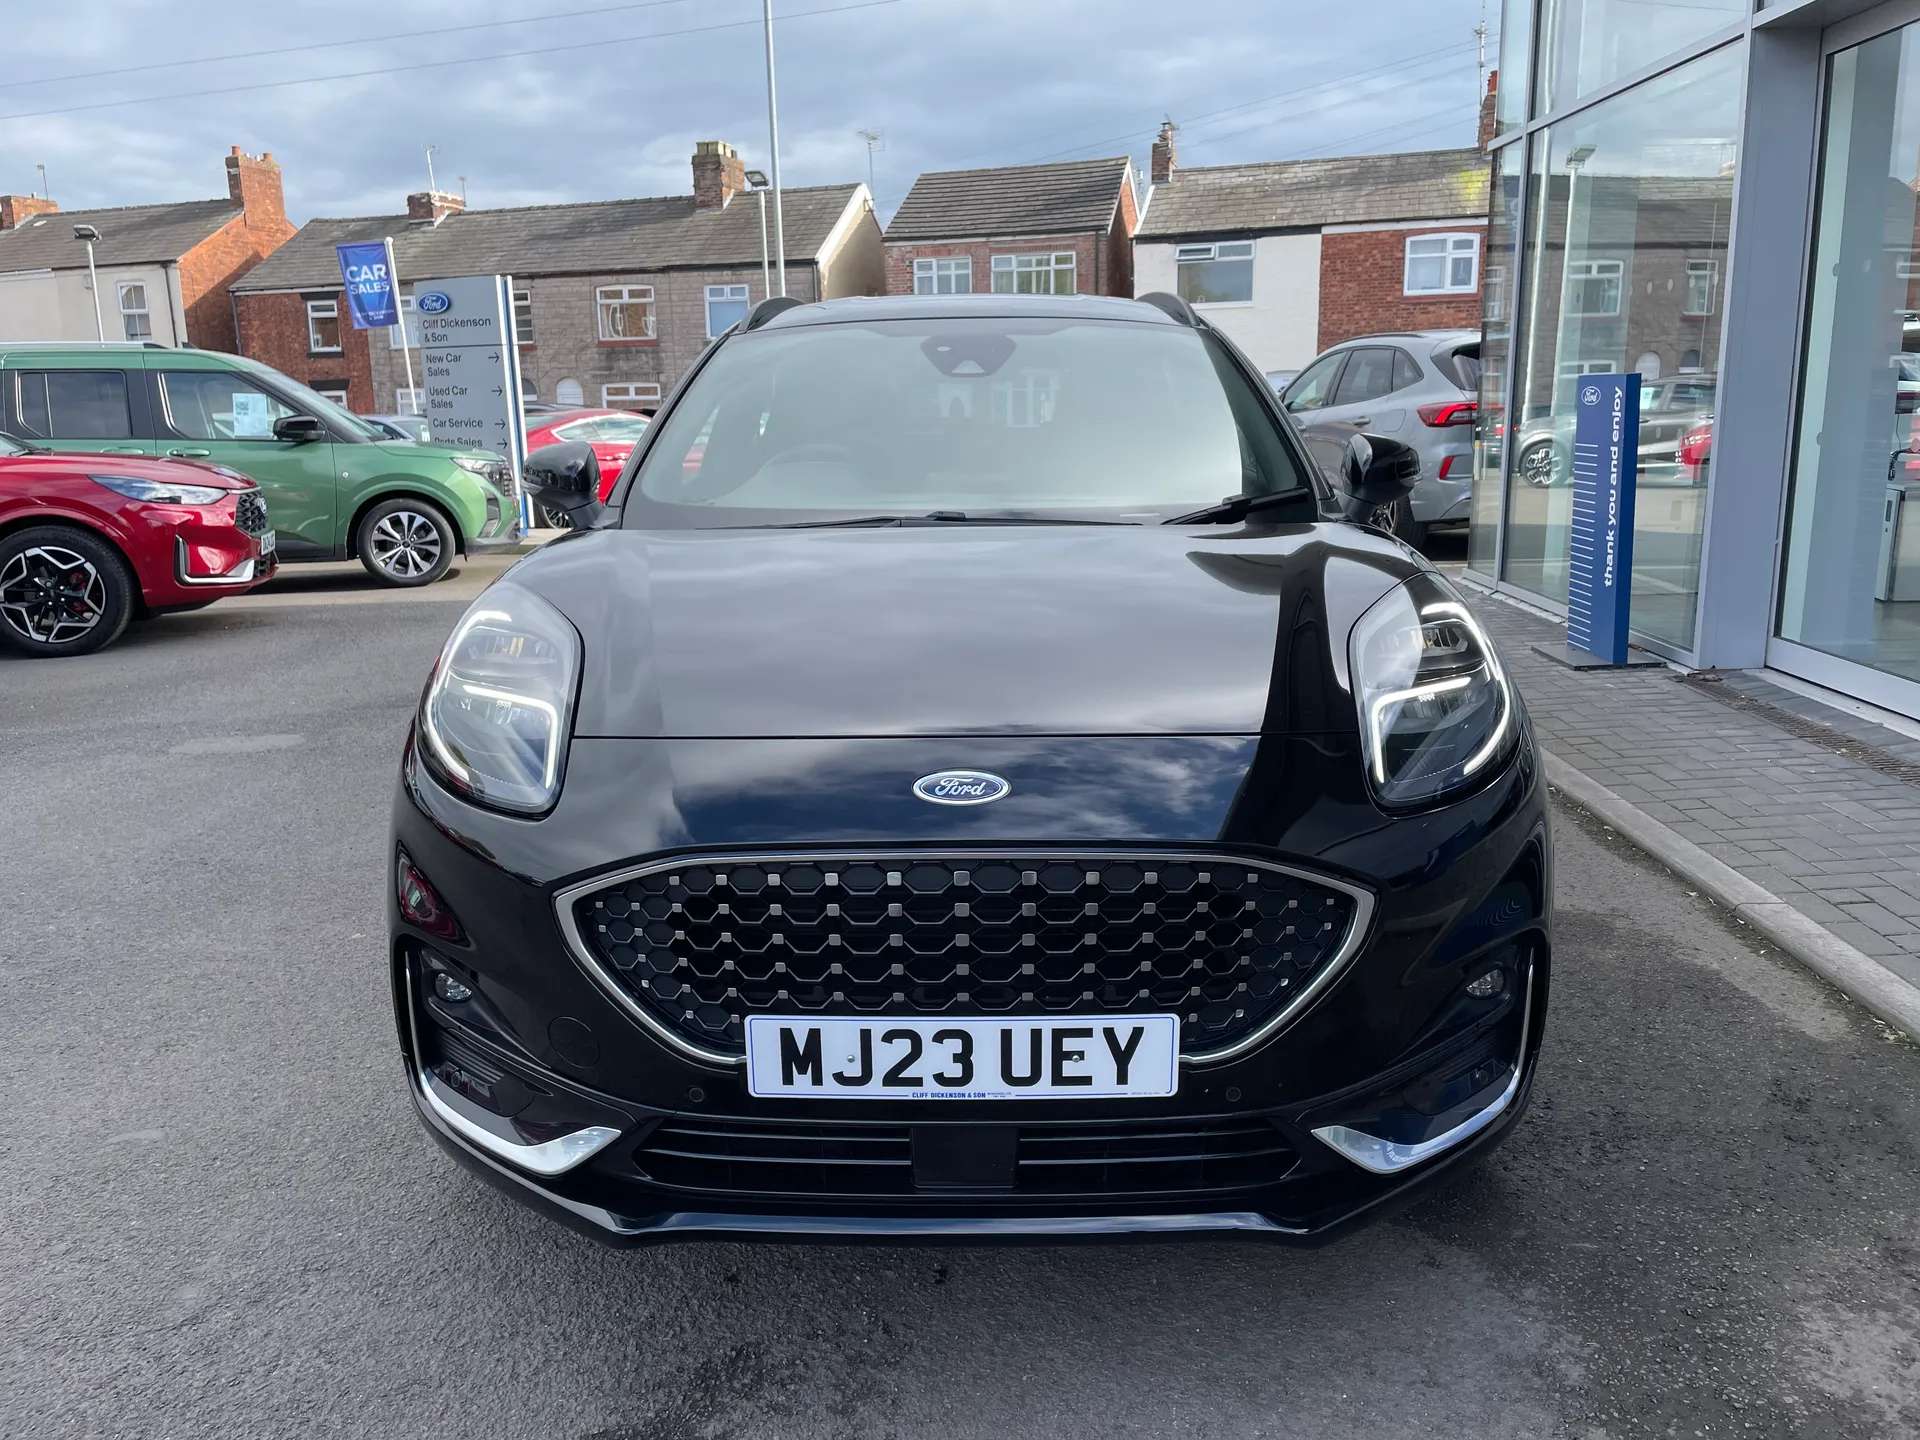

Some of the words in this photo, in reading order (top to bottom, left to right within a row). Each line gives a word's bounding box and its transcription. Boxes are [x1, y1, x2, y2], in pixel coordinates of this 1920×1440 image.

[346, 264, 388, 281] CAR
[350, 281, 390, 295] SALES
[422, 319, 439, 329] Cliff
[440, 317, 492, 329] Dickenson
[424, 333, 430, 342] &
[431, 332, 448, 342] Son
[426, 353, 444, 363] New
[445, 353, 462, 363] Car
[427, 367, 450, 377] Sales
[429, 386, 450, 396] Used
[451, 385, 468, 396] Car
[431, 399, 454, 409] Sales
[1612, 386, 1623, 442] enjoy
[432, 418, 447, 428] Car
[448, 418, 484, 428] Service
[1610, 446, 1619, 486] and
[1607, 490, 1617, 527] you
[1604, 529, 1615, 588] thank
[934, 777, 987, 796] Ford
[779, 1027, 974, 1088] MJ23
[1000, 1026, 1145, 1087] UEY
